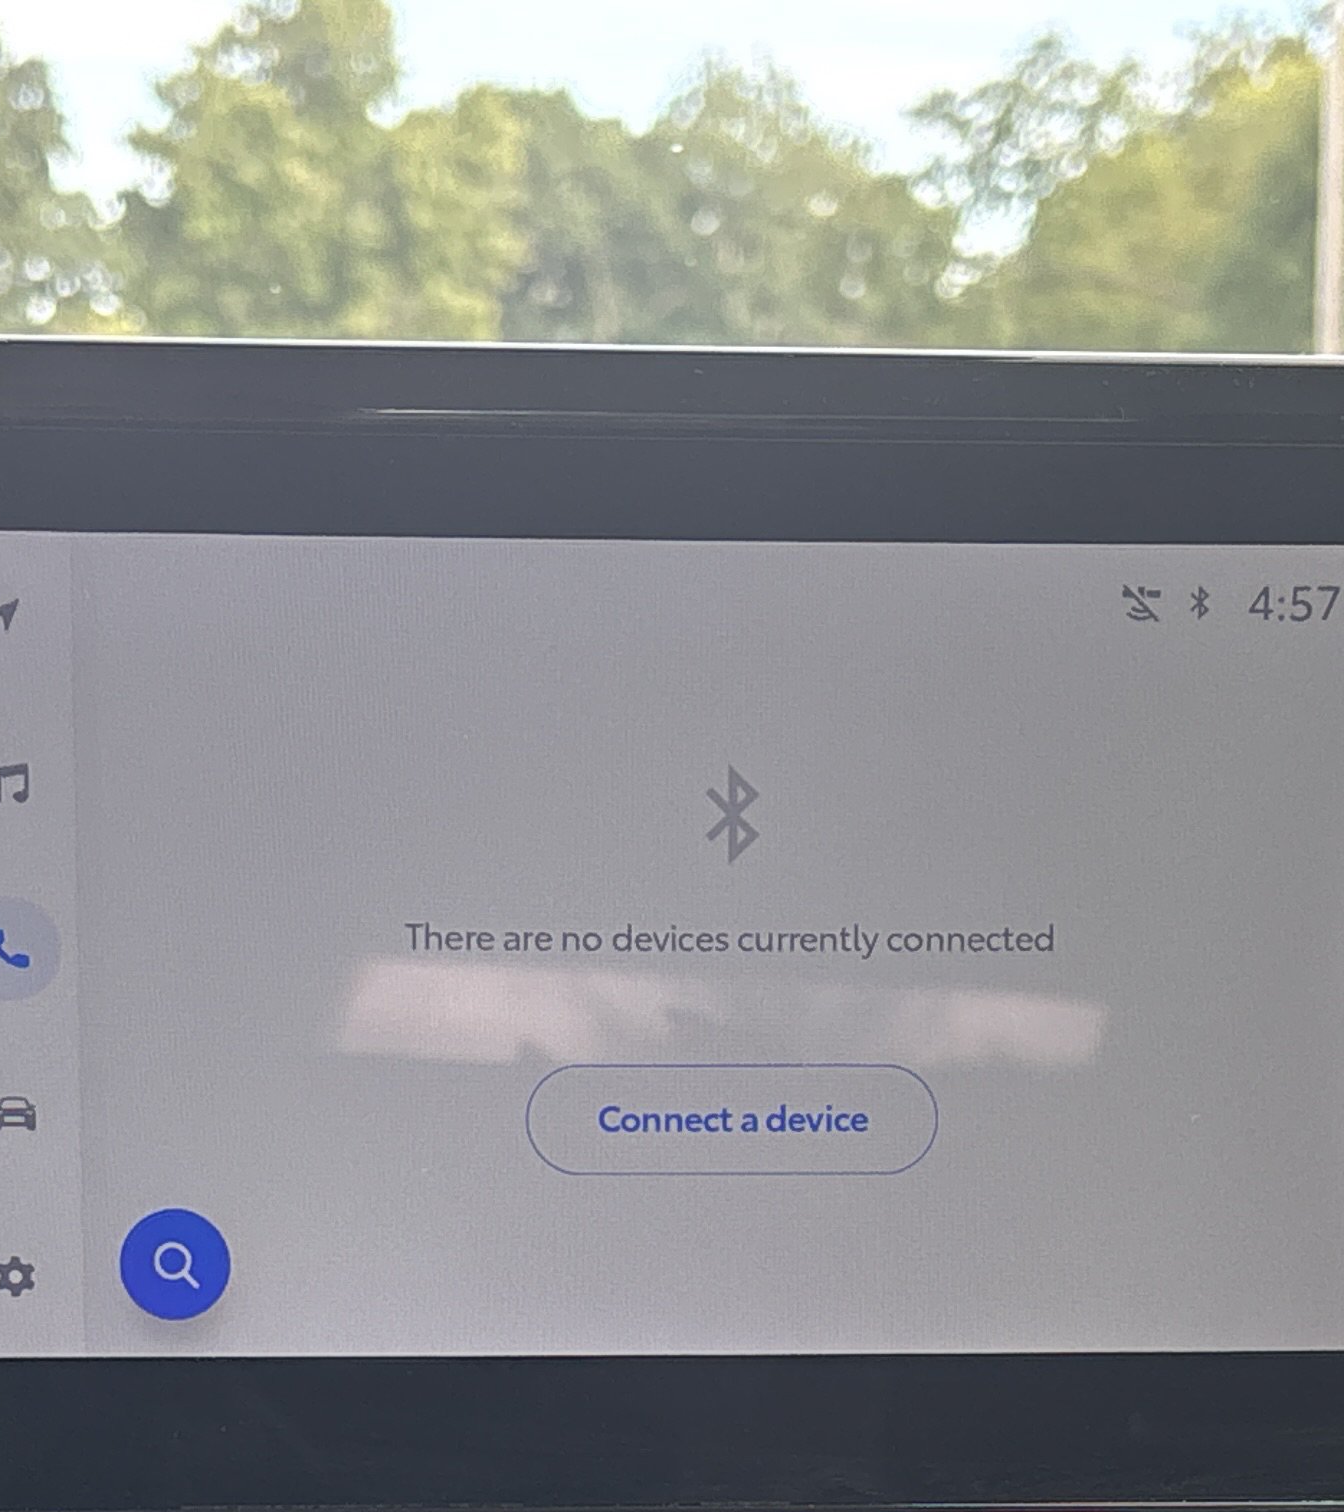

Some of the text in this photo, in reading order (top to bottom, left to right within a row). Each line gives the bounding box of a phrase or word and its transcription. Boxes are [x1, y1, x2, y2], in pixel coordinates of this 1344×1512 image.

[1247, 584, 1342, 622] 4:57
[405, 922, 1055, 959] There are no devices currently connected
[598, 1105, 870, 1134] Connect a device
